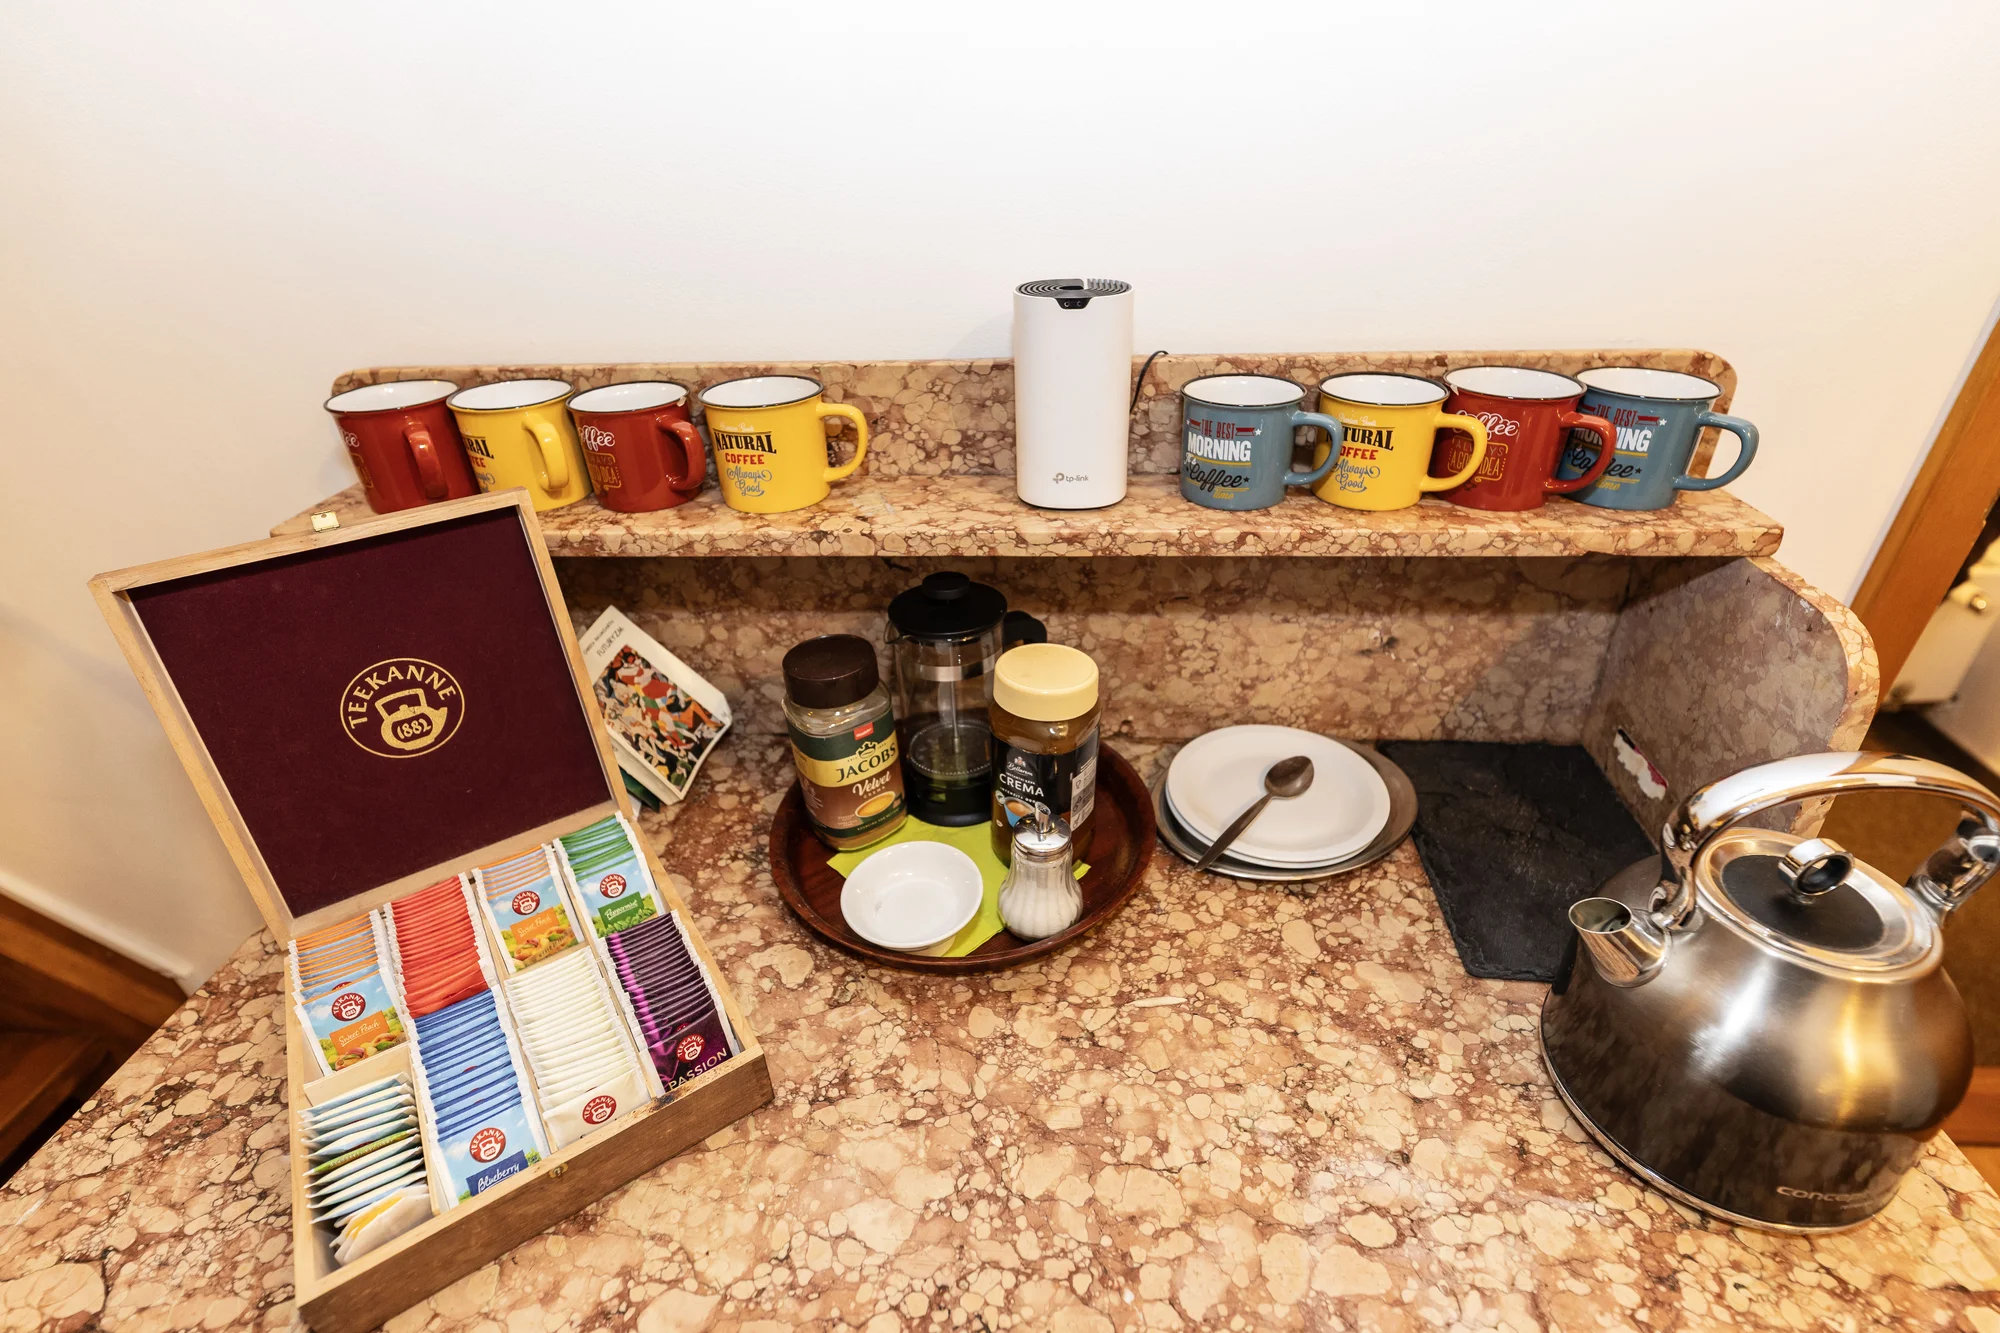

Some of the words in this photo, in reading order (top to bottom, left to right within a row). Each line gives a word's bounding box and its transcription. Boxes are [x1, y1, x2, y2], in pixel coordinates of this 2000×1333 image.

[1595, 403, 1612, 419] THE
[1613, 407, 1638, 428] BEST
[1201, 419, 1213, 437] THE
[1216, 422, 1236, 440] BEST
[713, 431, 777, 454] NATURAL
[1187, 431, 1252, 462] MORNING
[1340, 445, 1379, 460] OFFEE
[725, 452, 765, 464] COFFEE
[1331, 458, 1381, 479] Always
[726, 465, 773, 483] Always
[1188, 461, 1242, 493] Coffee
[1335, 473, 1367, 493] Good
[735, 479, 765, 497] Good
[1212, 490, 1235, 500] time
[348, 664, 457, 730] TEEKANNE
[396, 718, 432, 740] 1882
[836, 742, 896, 783] JACOBS
[852, 770, 891, 797] Velvet
[999, 773, 1044, 798] CREMA
[338, 1030, 360, 1046] Sweet
[358, 1018, 381, 1034] Peach
[668, 1047, 728, 1091] PASSION
[471, 1129, 505, 1155] TEEKANNE
[477, 1163, 520, 1194] Blueberry
